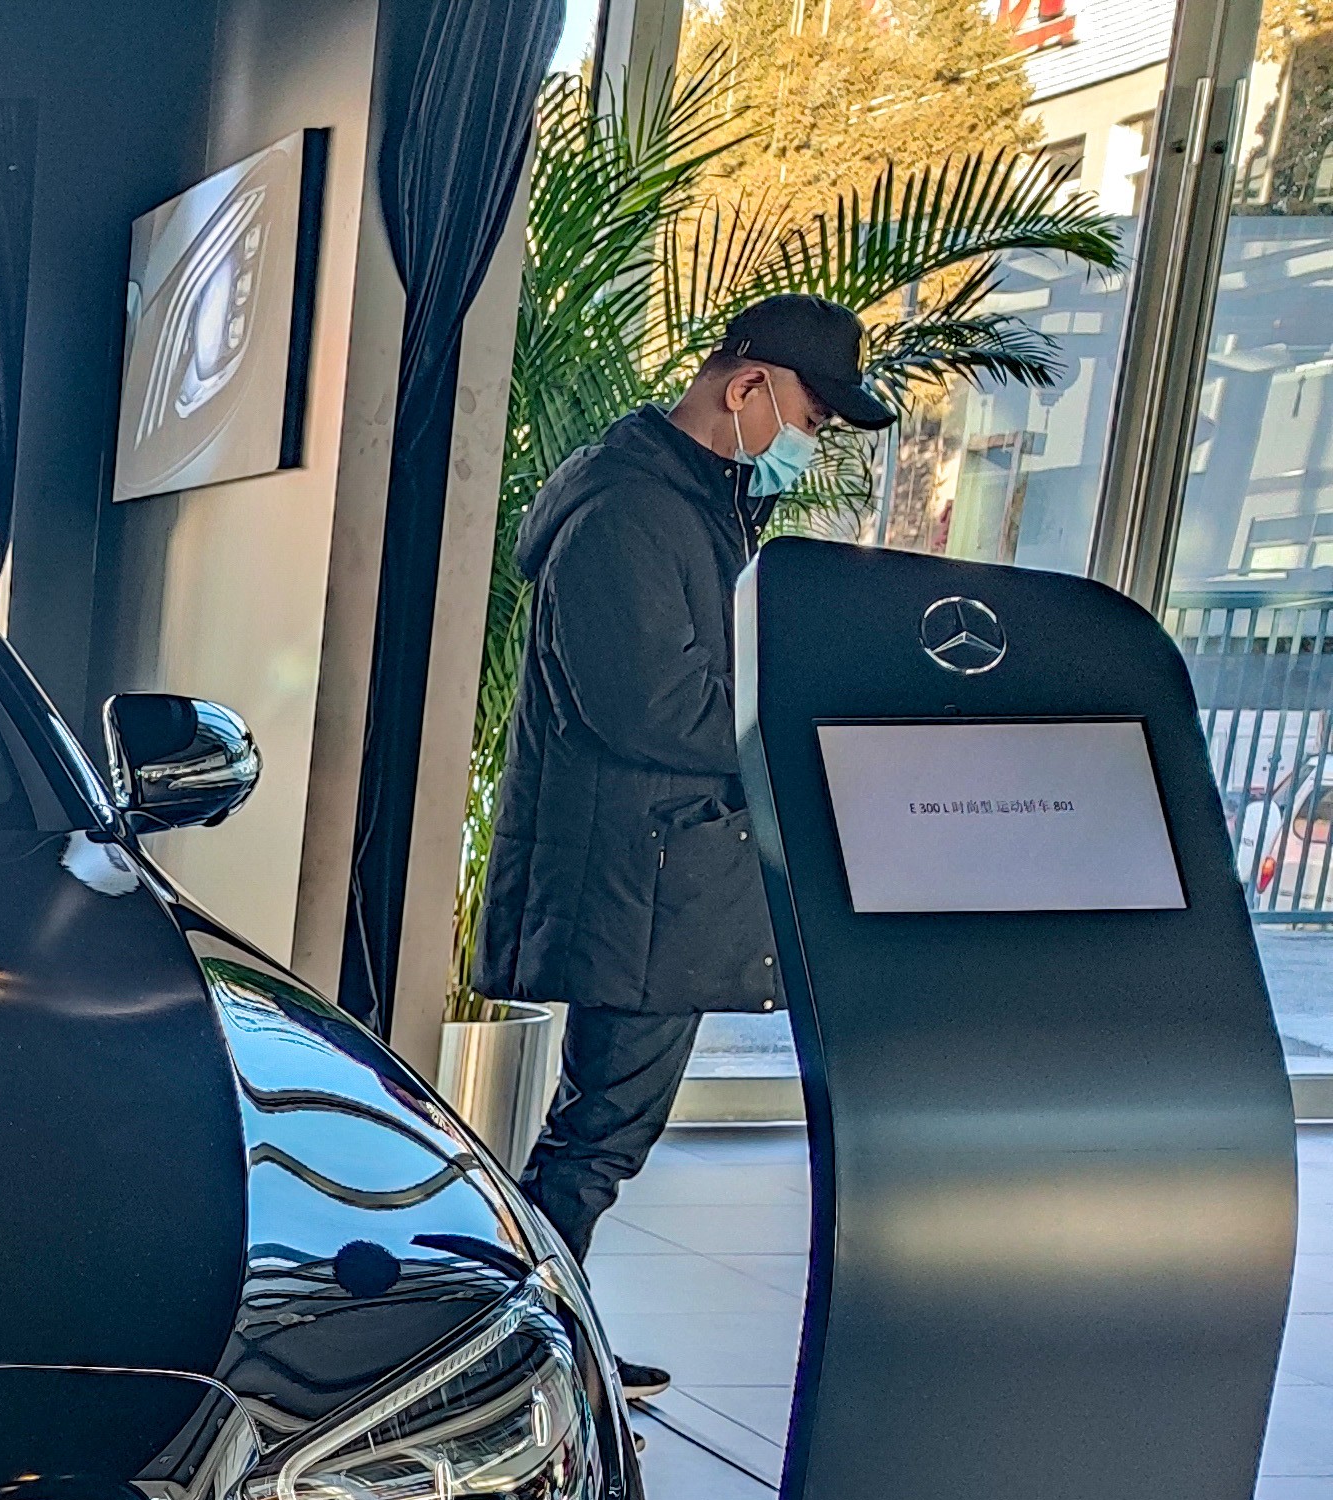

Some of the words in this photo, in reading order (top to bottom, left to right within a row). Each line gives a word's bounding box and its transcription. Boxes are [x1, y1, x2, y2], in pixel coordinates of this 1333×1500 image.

[909, 803, 917, 814] E
[919, 802, 940, 814] 300
[943, 803, 950, 814] L
[1053, 800, 1075, 812] 801
